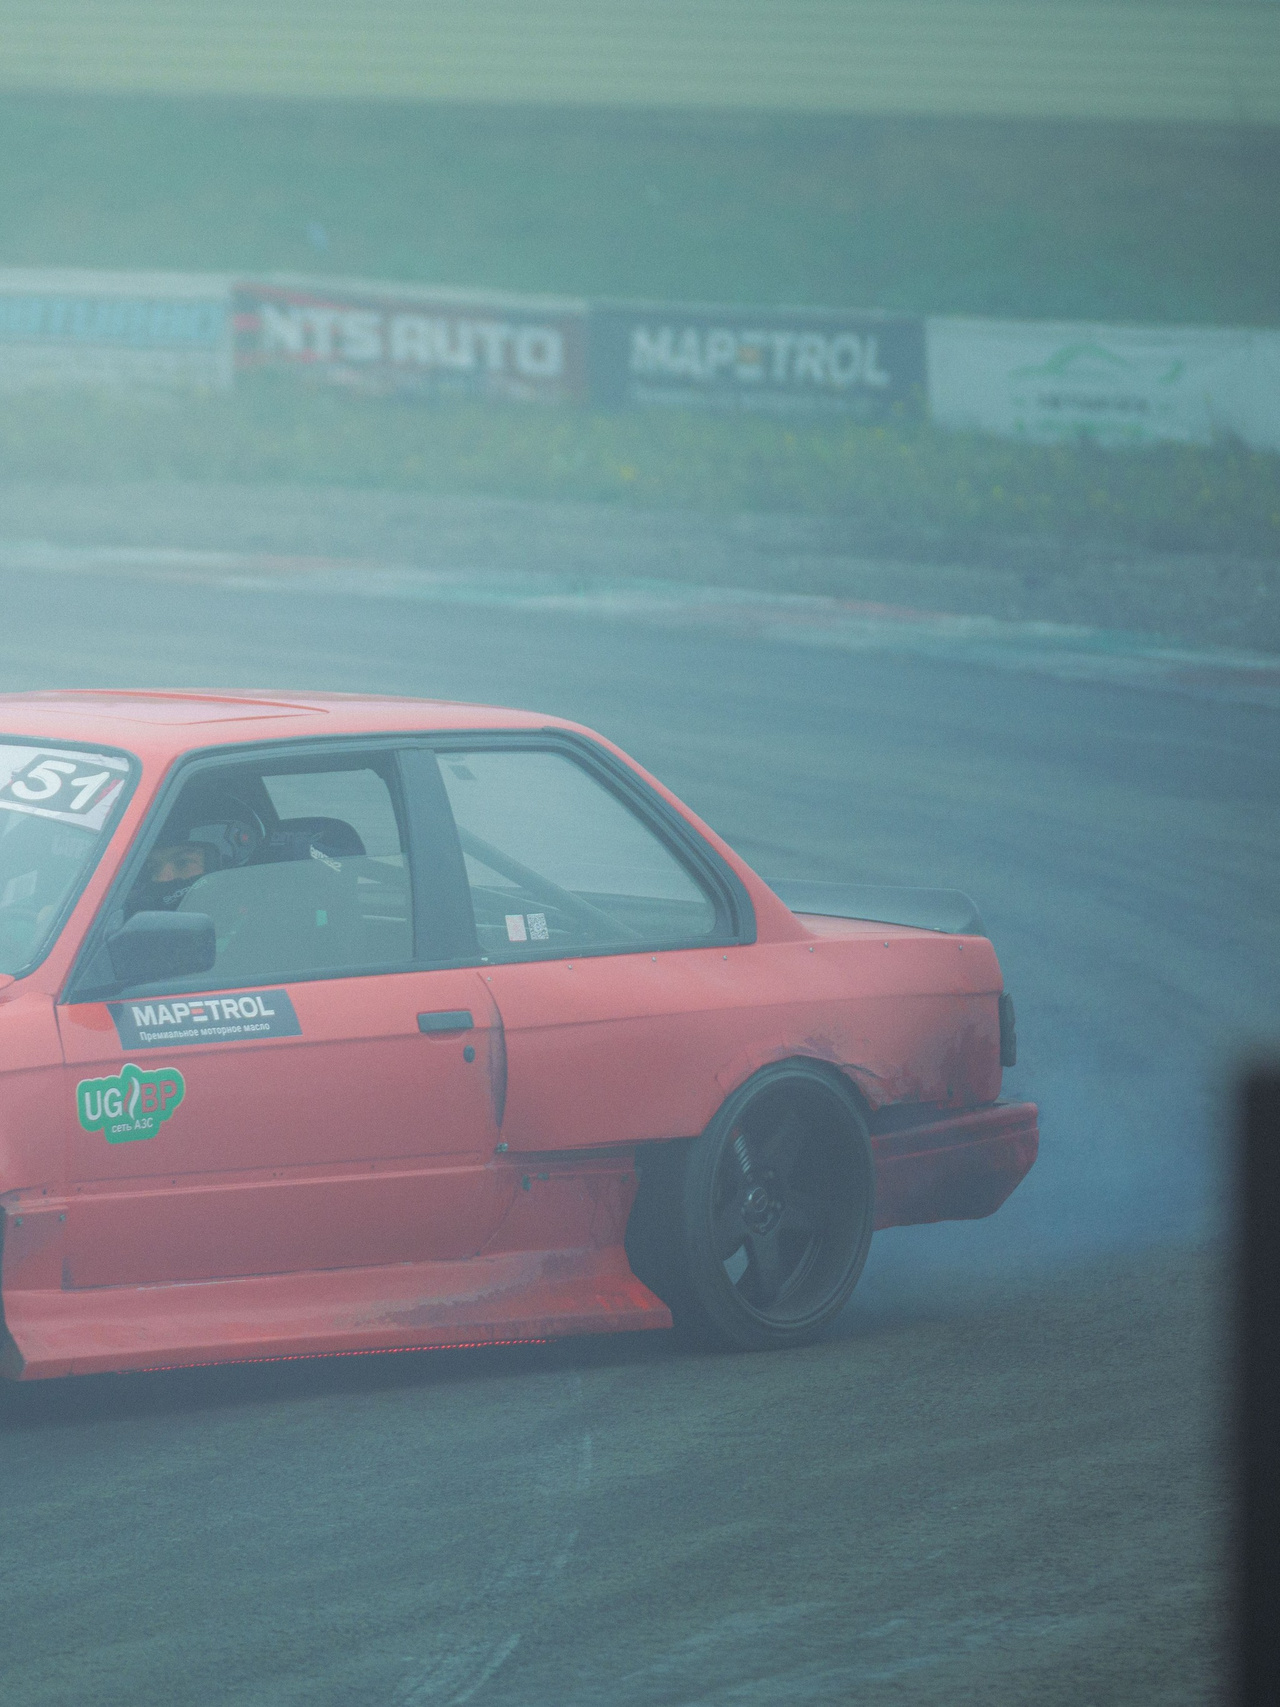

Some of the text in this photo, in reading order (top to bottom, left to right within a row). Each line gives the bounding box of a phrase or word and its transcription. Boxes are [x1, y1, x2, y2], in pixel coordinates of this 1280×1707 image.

[260, 303, 383, 361] NTS
[390, 313, 564, 377] AUTO
[630, 325, 891, 387] MAPETROL
[10, 759, 110, 810] 51
[131, 996, 275, 1027] MAPETROL
[139, 1023, 270, 1042] Премиальное моторное масло
[111, 1117, 154, 1133] сеть АЗС
